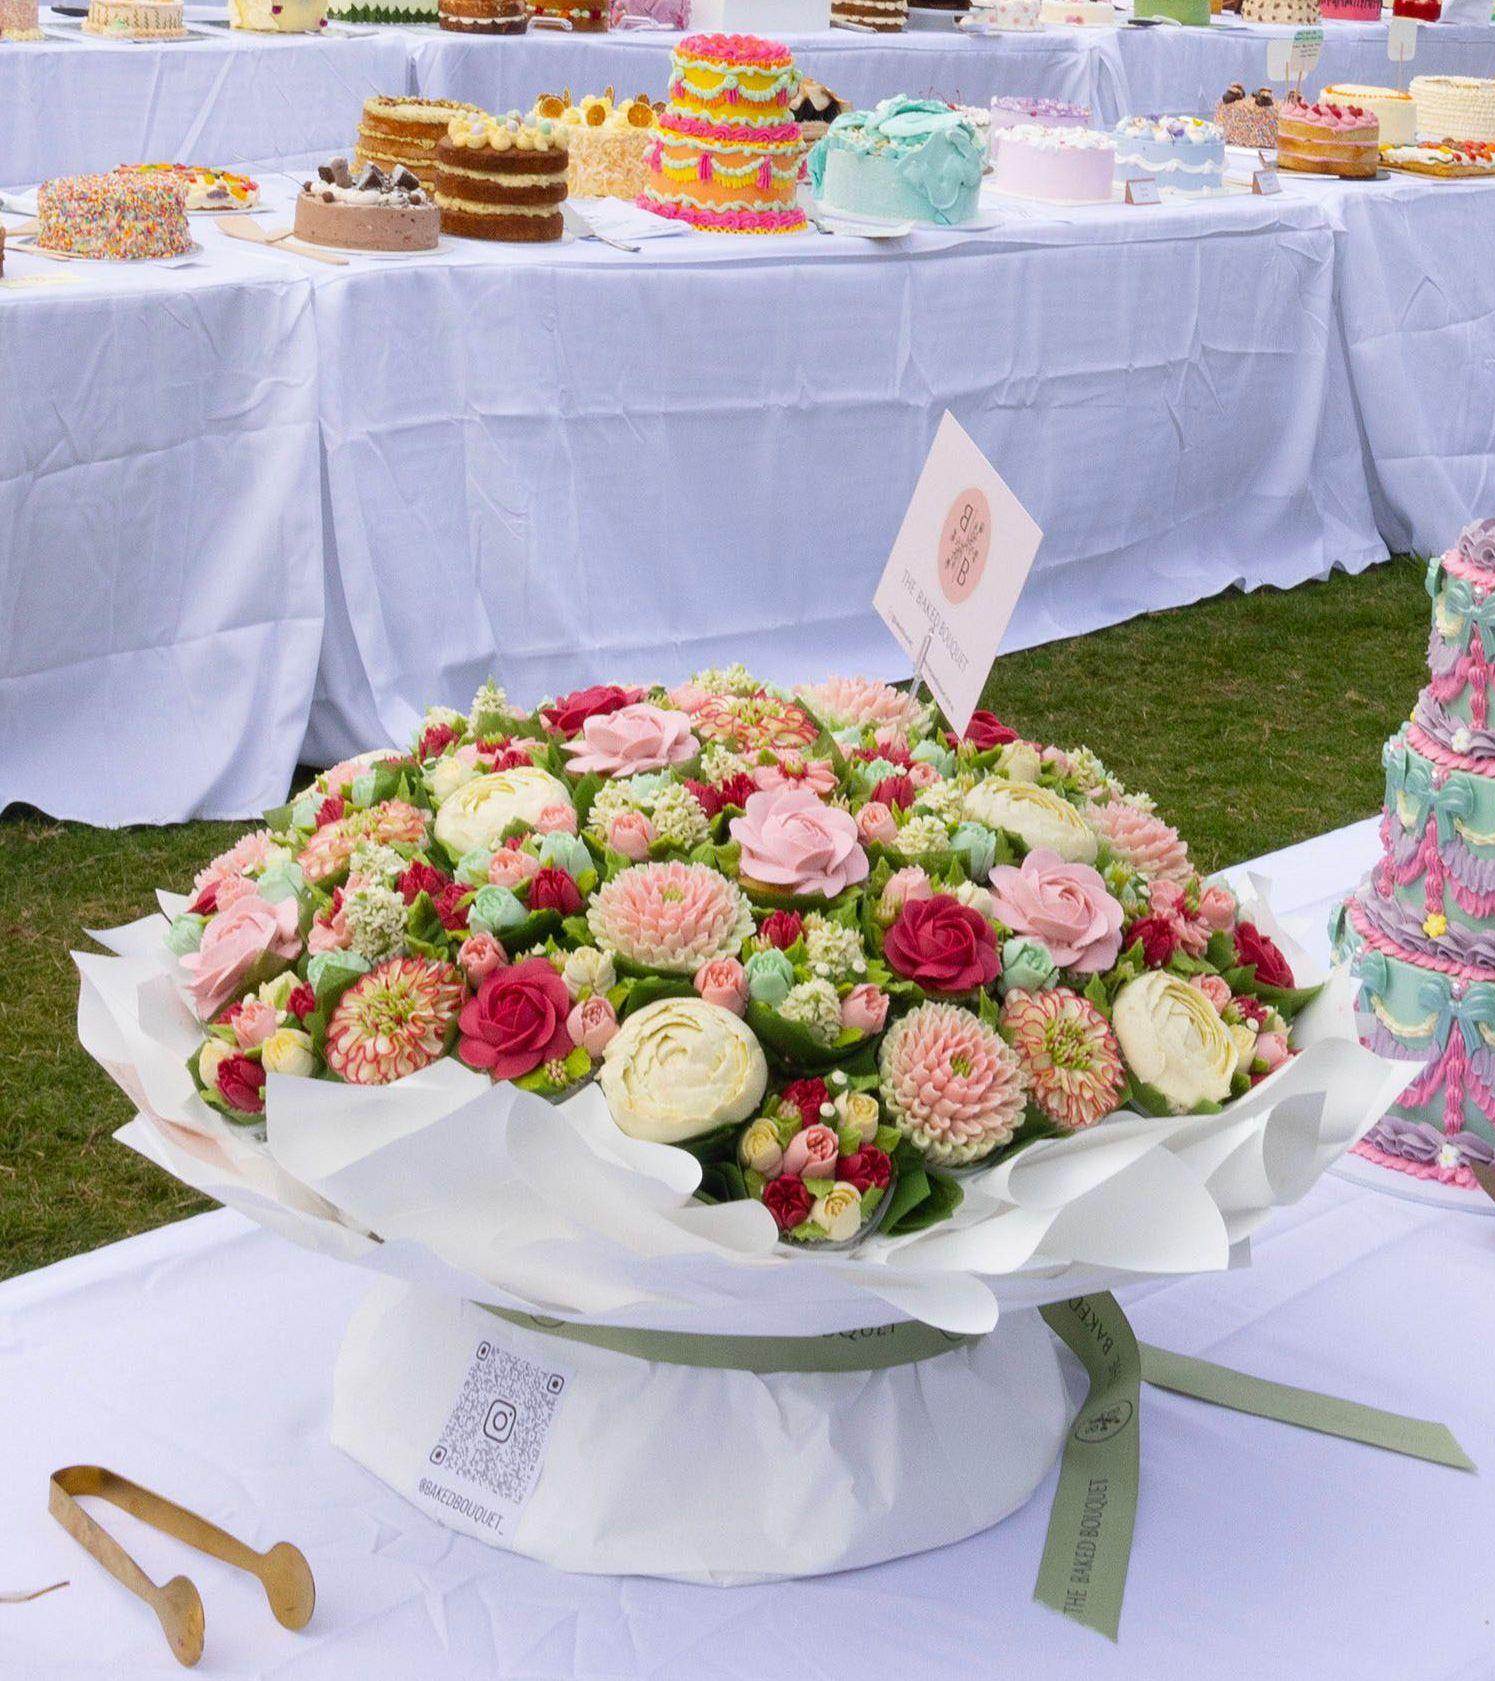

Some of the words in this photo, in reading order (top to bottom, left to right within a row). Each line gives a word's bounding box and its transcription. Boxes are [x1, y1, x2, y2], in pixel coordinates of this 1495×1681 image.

[901, 569, 916, 597] THE
[915, 588, 941, 629] BAKED
[937, 621, 969, 675] BOUQUET
[1069, 1296, 1114, 1355] BAKED
[1080, 1479, 1108, 1537] BOUQUET
[1069, 1541, 1096, 1584] BAKED
[1063, 1590, 1088, 1615] THE
